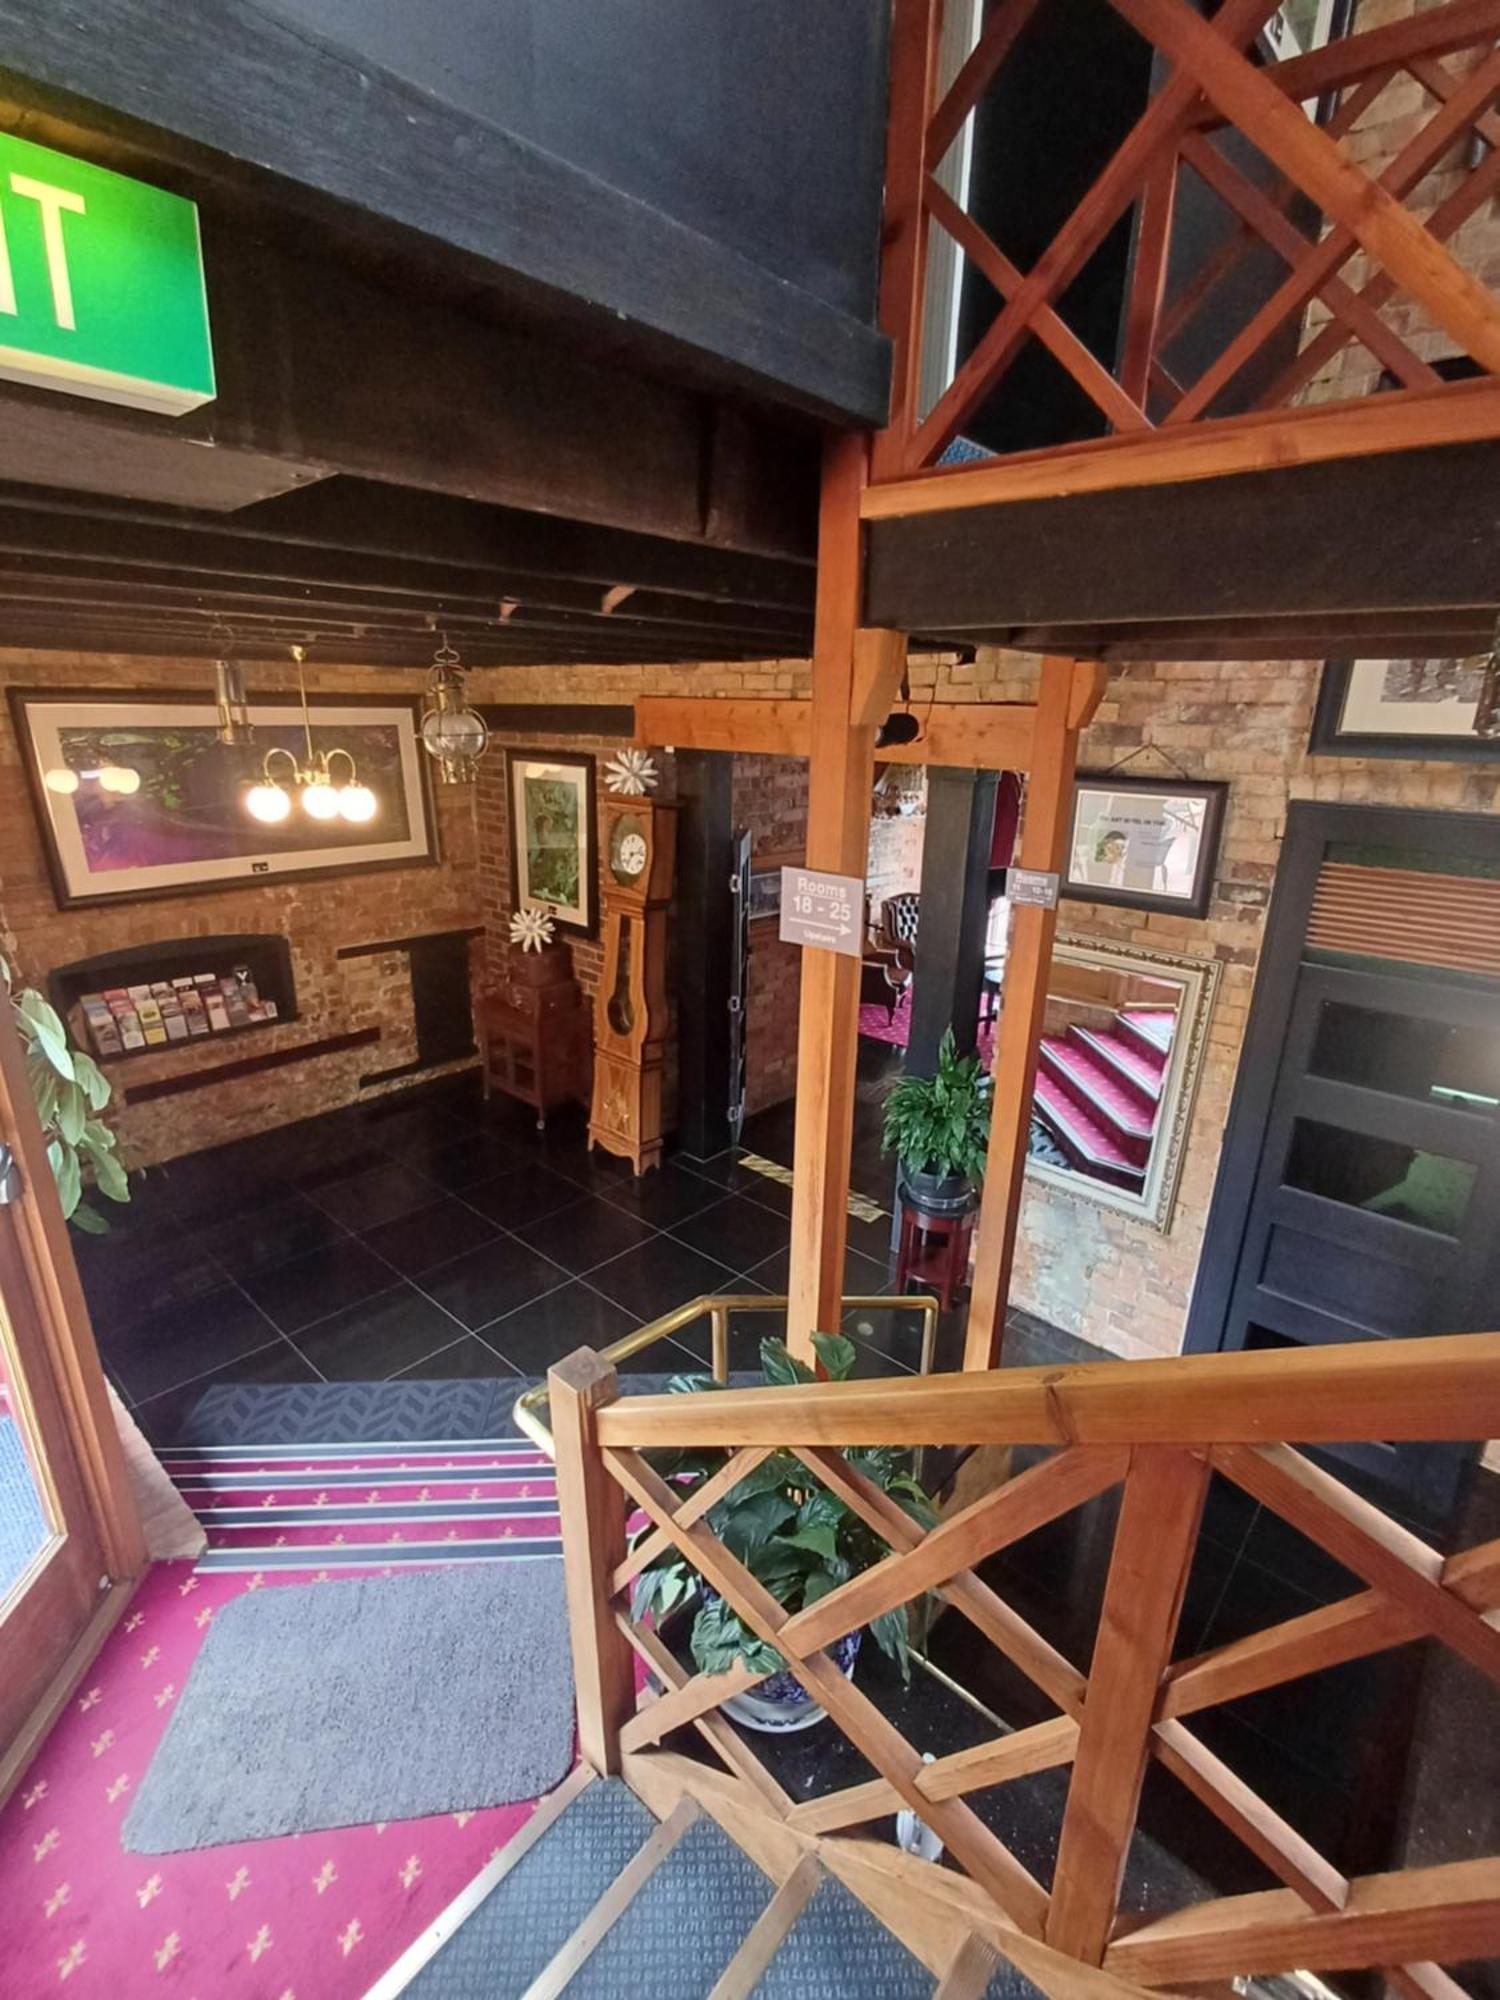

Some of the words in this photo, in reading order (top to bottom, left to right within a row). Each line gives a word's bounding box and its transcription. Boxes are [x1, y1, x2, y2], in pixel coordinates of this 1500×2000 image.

[797, 876, 847, 898] Rooms
[793, 895, 812, 914] 18
[829, 902, 851, 922] 25
